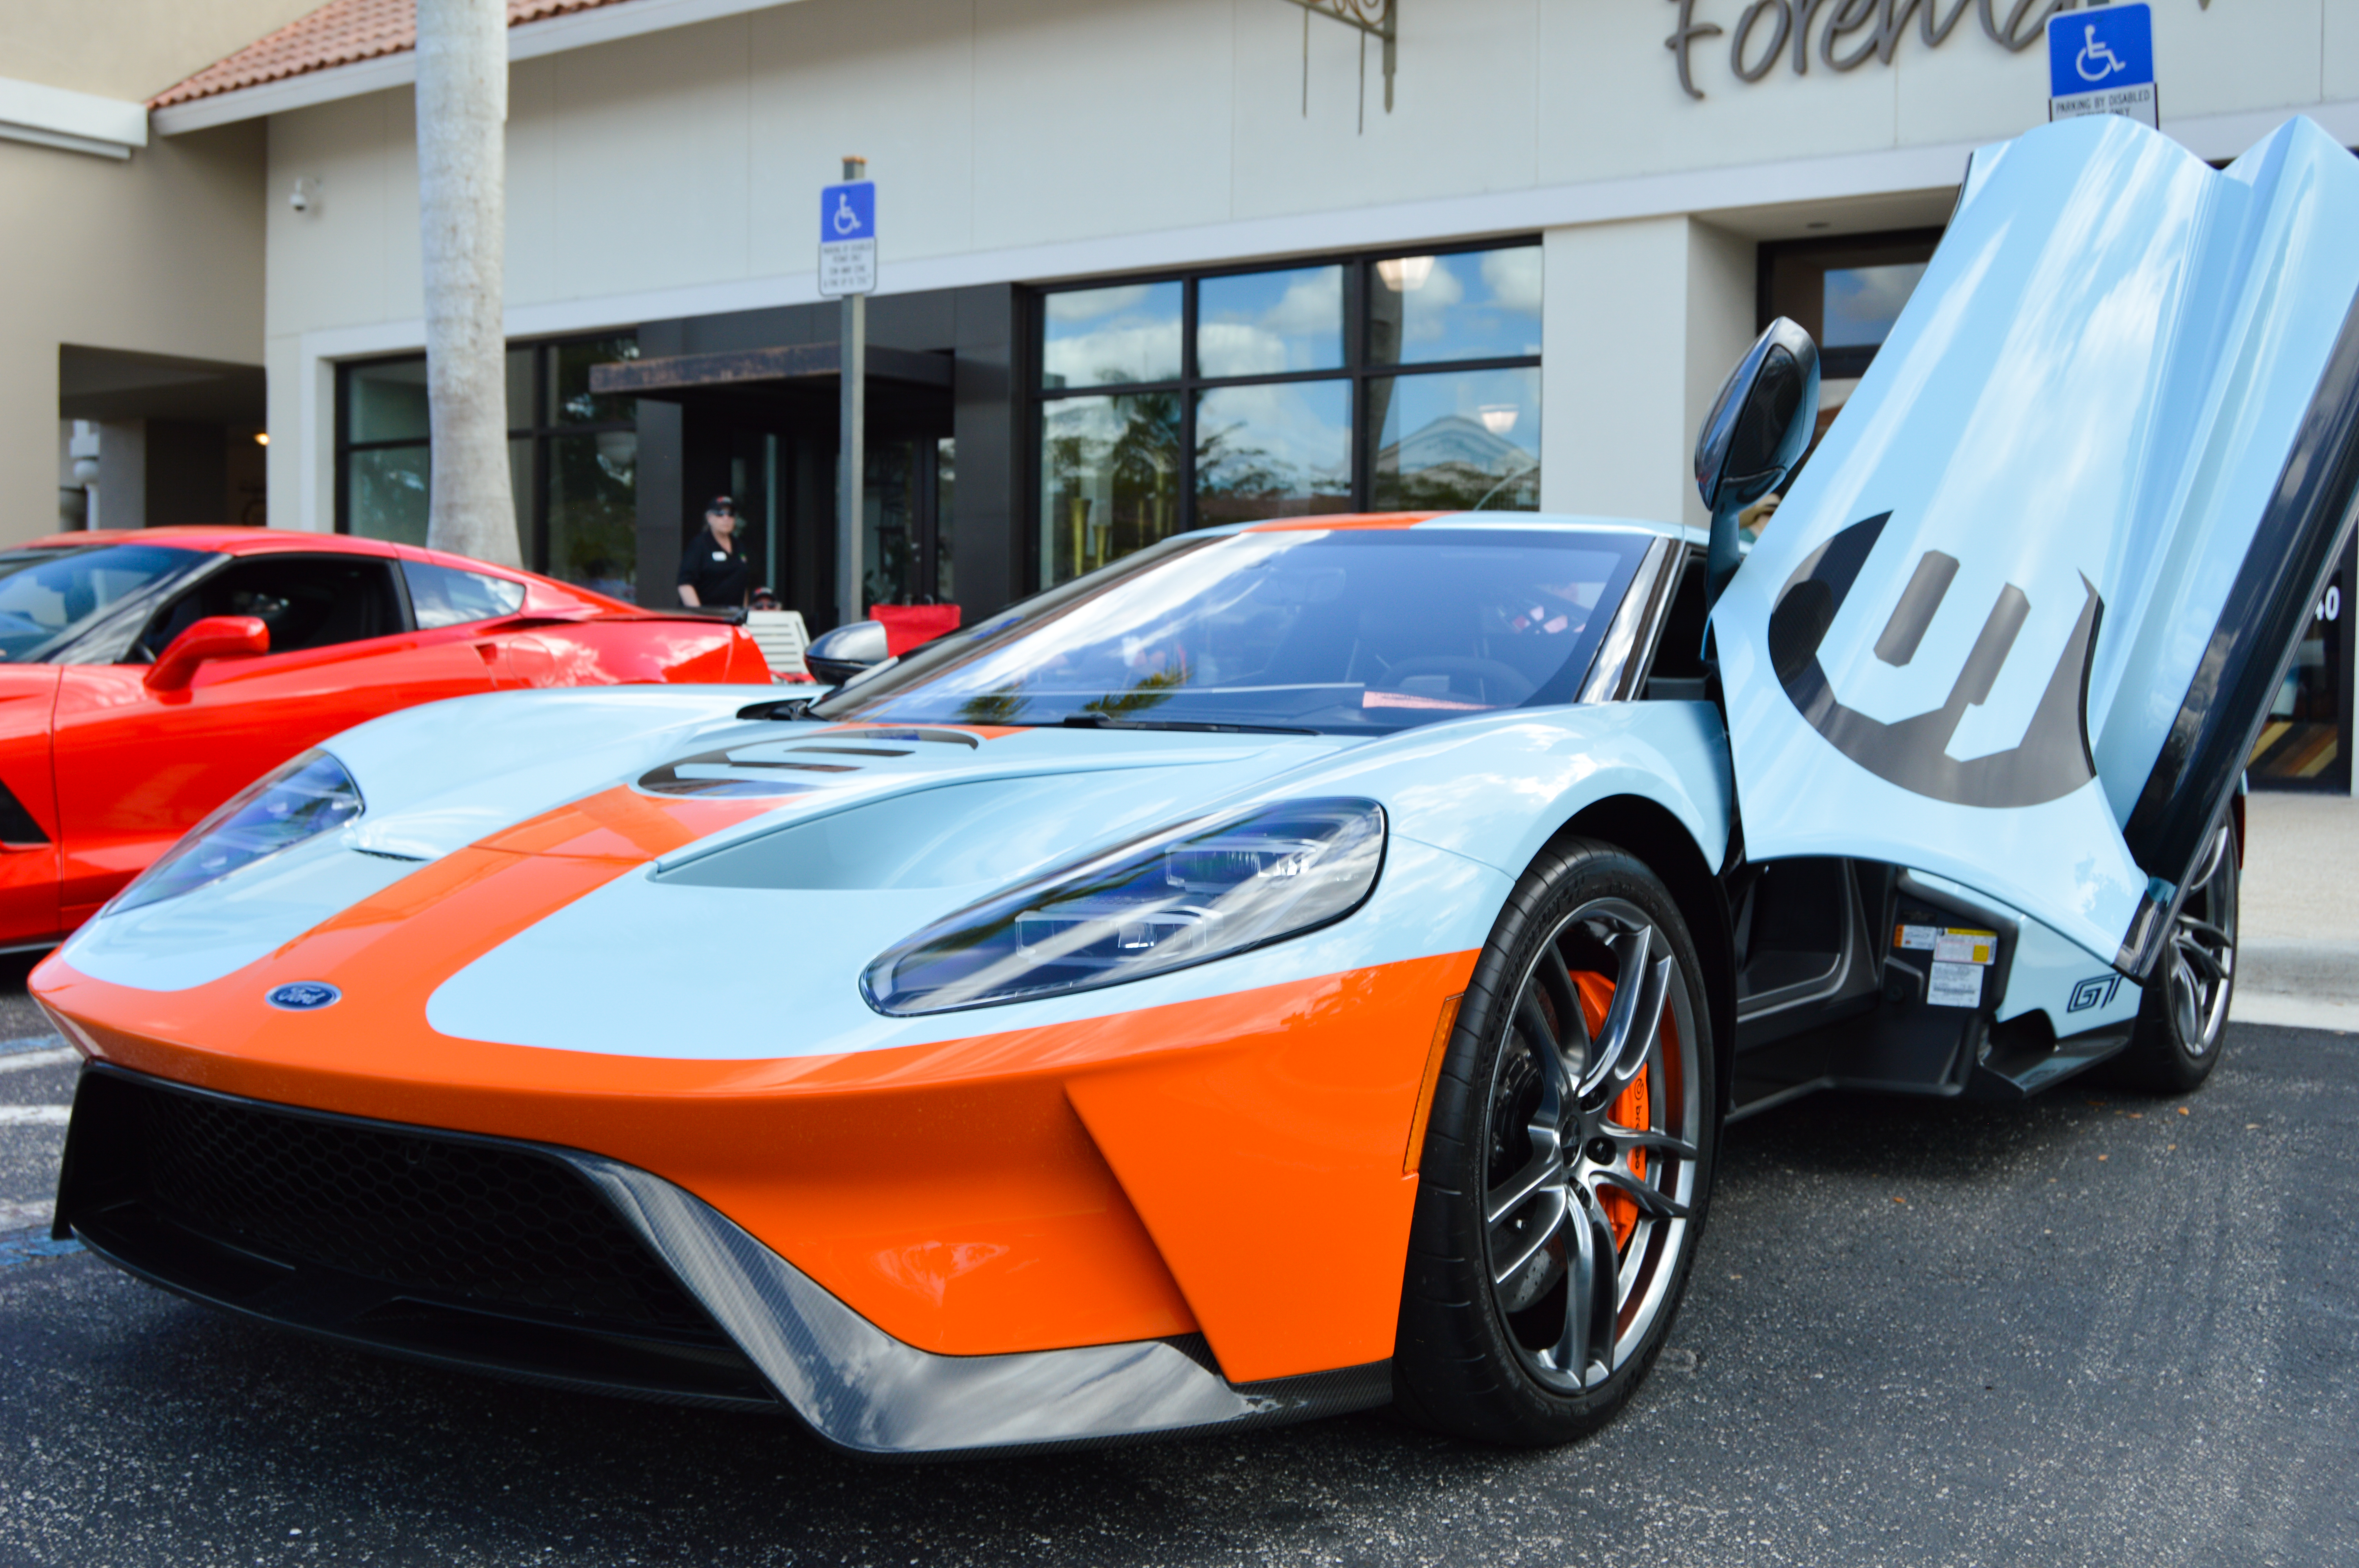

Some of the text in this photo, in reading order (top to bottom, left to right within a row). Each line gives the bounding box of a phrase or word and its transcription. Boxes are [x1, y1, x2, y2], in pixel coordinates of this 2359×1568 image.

[2056, 89, 2150, 114] PARKING BY DISABLED
[2066, 972, 2123, 1013] GT
